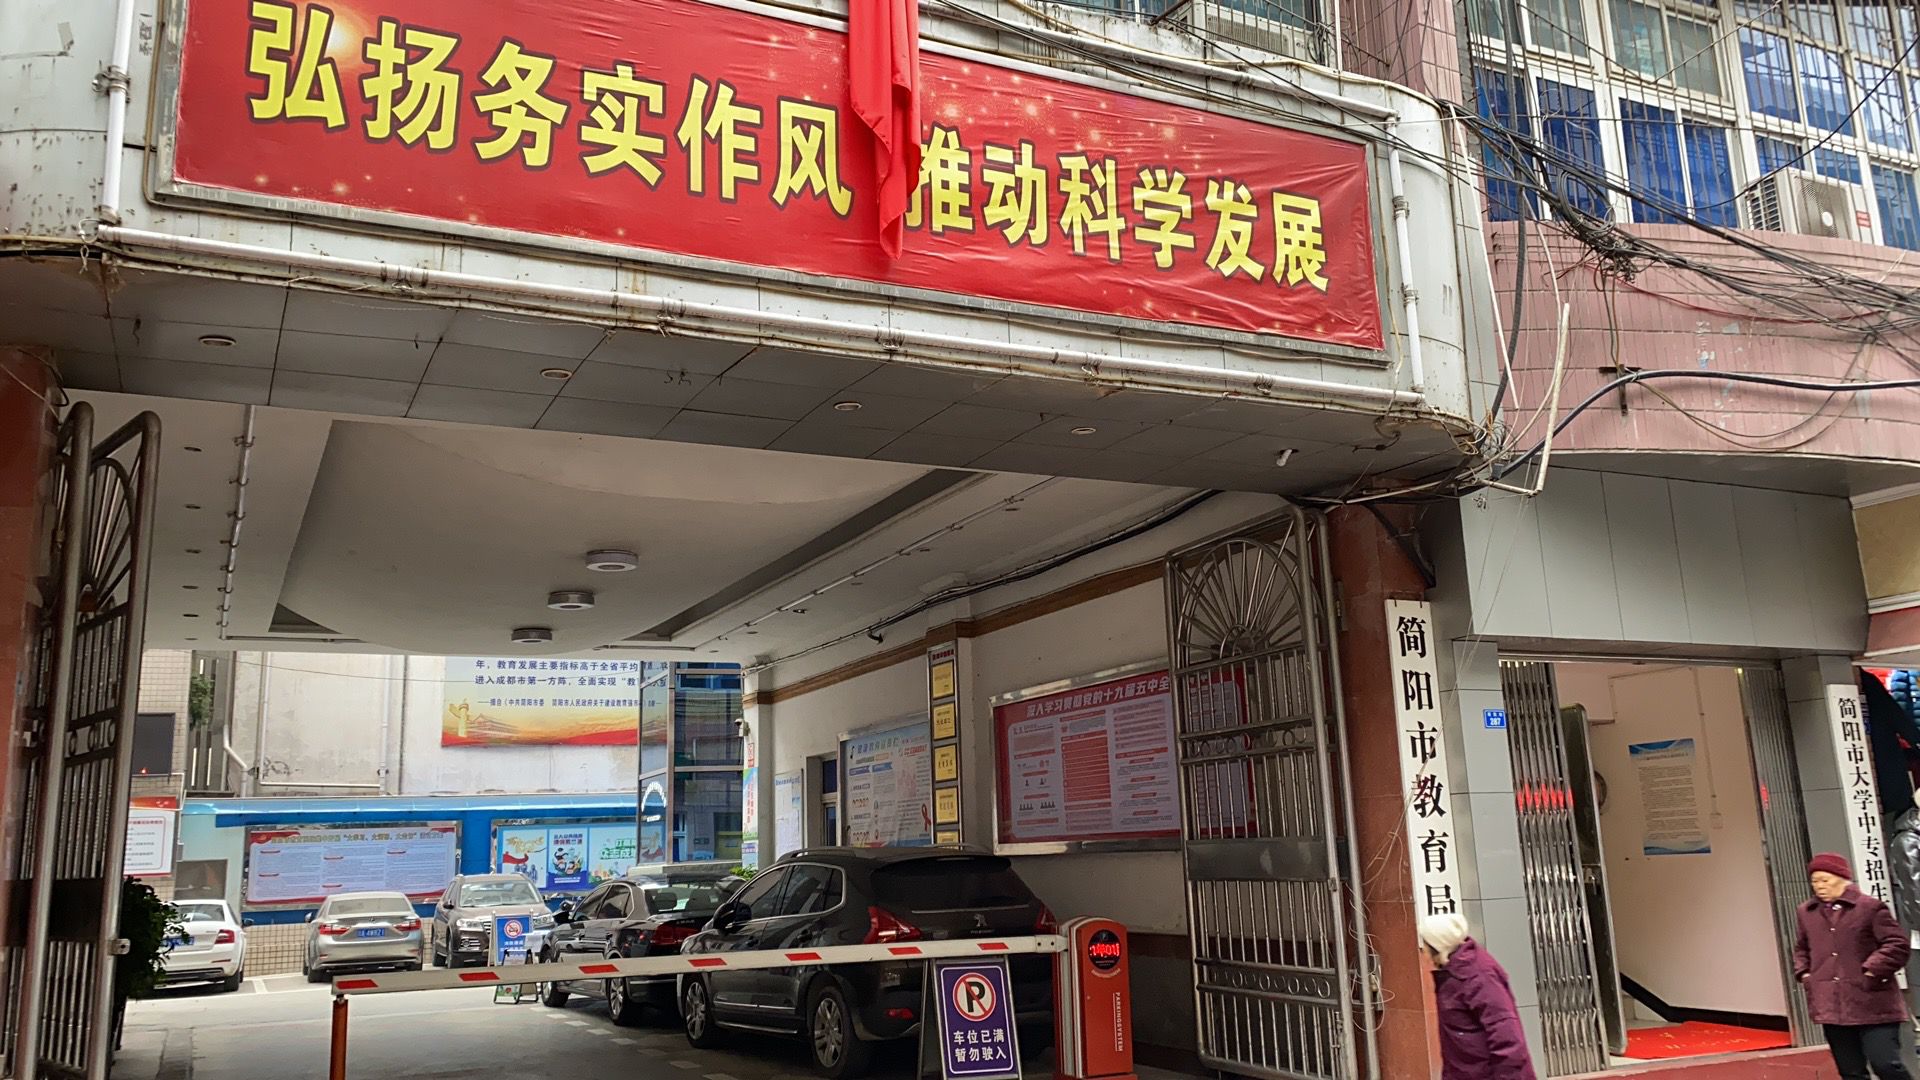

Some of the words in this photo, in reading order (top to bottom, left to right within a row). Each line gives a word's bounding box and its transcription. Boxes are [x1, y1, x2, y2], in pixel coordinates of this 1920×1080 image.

[247, 0, 854, 219] 弘扬务实作风
[905, 121, 1330, 293] 推动科学发展
[475, 675, 640, 687] 进入成都市第一方阵，全面实现“教
[1396, 616, 1456, 916] 简阳市教育局
[1837, 697, 1891, 904] 简阳市大学中专招生
[953, 1028, 1005, 1045] 车位已满
[955, 1046, 1007, 1063] 暂勿驶入
